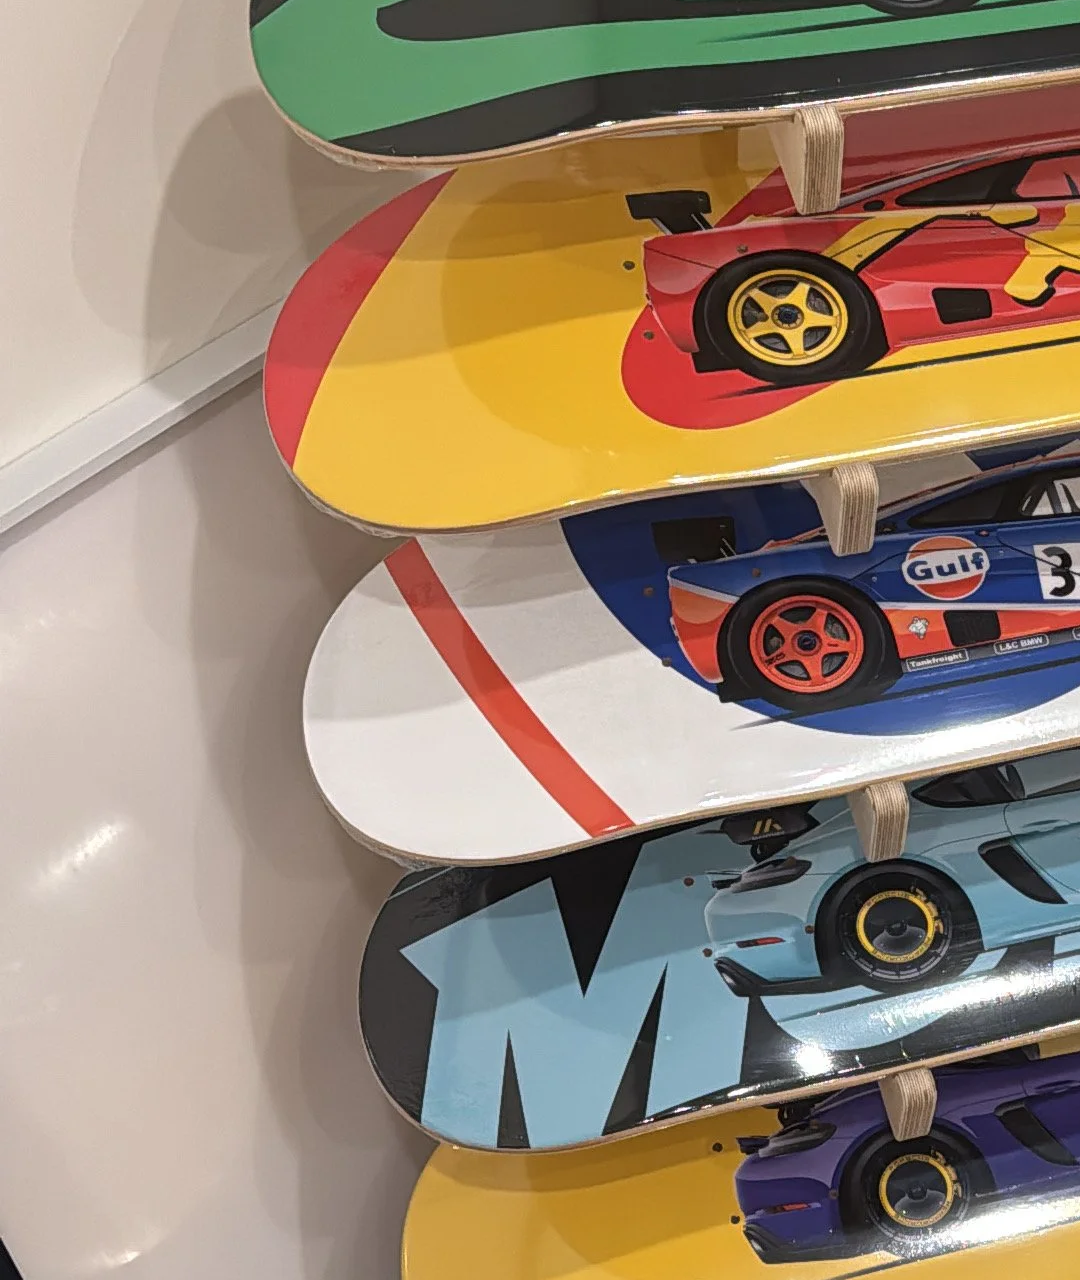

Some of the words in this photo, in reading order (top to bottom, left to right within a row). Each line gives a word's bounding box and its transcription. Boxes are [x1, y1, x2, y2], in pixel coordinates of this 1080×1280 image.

[906, 551, 985, 582] Gulf
[999, 640, 1019, 652] L&C
[1020, 636, 1044, 648] BMW
[909, 651, 963, 668] Tankfreight
